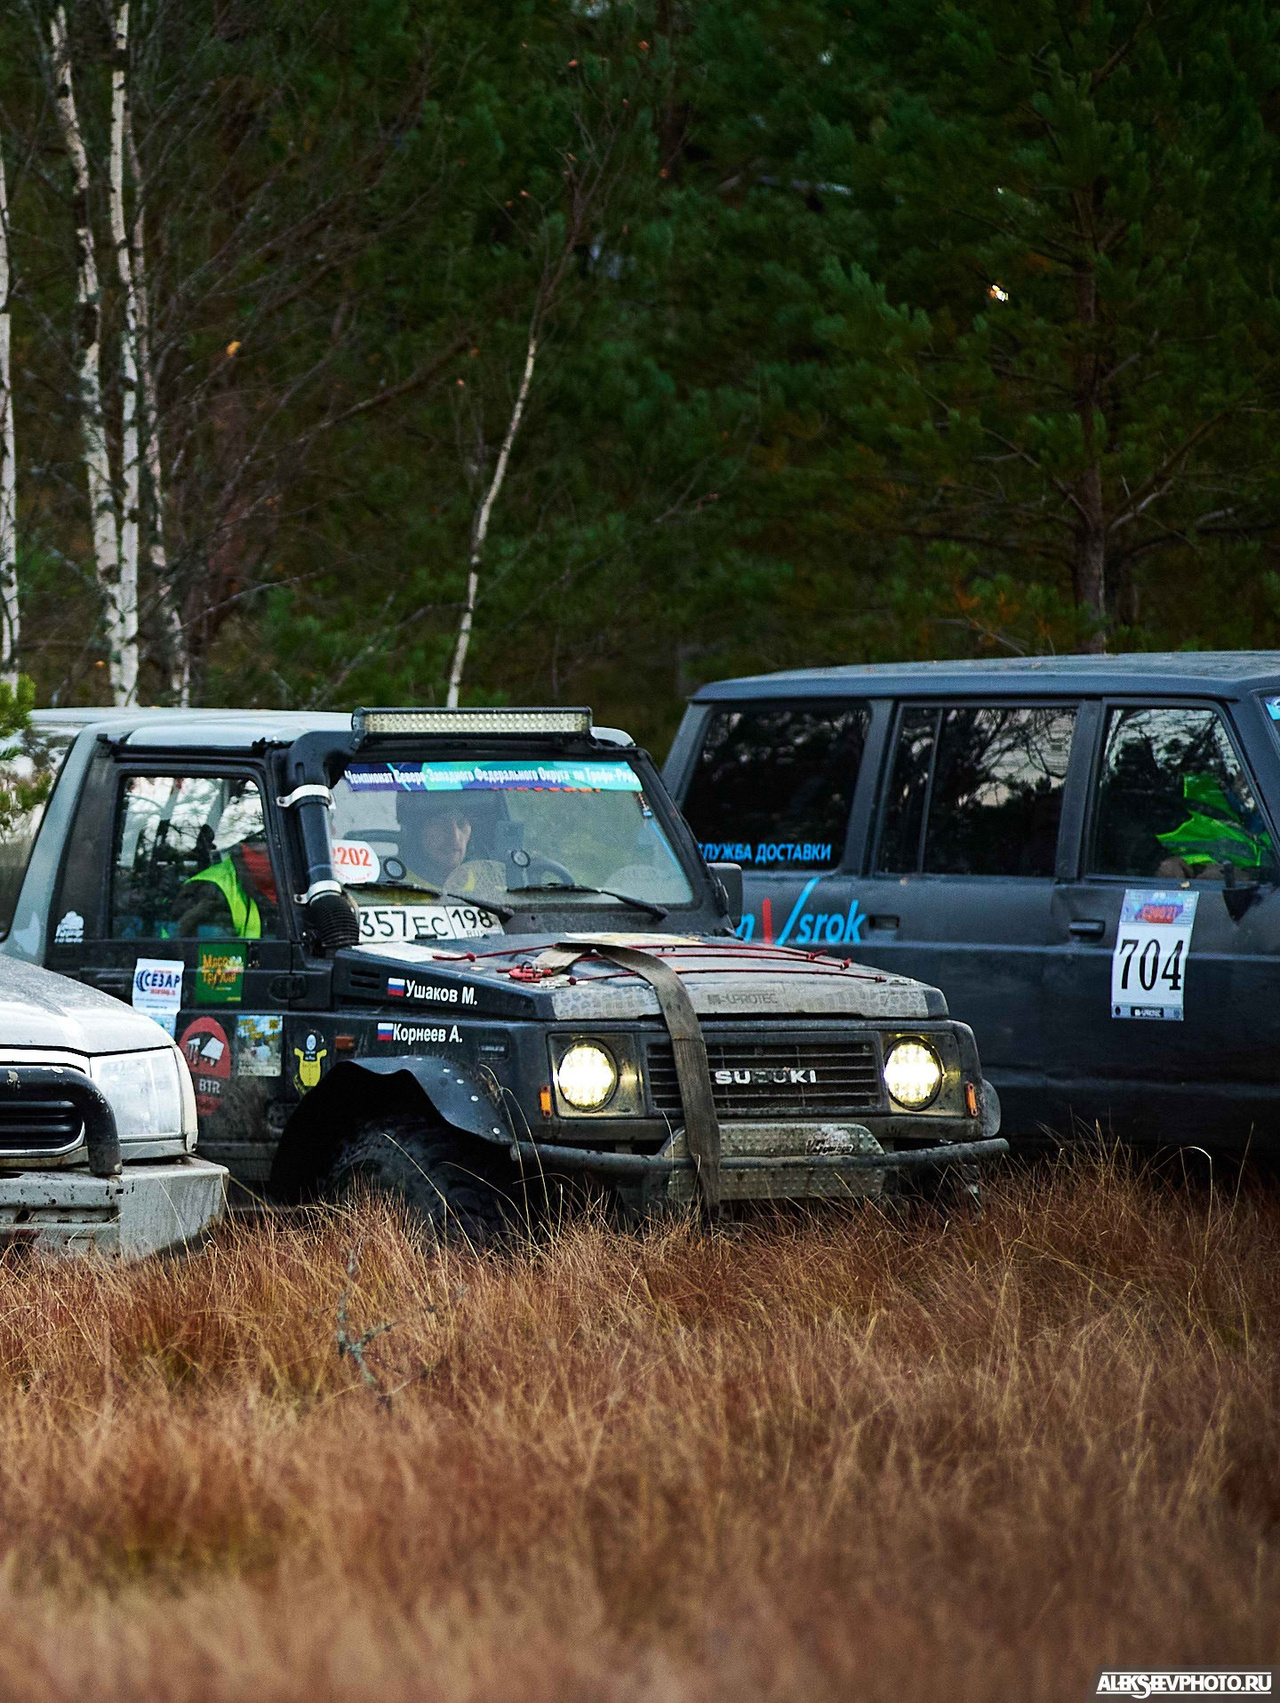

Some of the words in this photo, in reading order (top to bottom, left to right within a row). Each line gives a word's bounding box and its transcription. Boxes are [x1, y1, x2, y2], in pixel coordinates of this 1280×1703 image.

[344, 769, 394, 785] Чемпионат
[393, 768, 475, 786] Северо-Западного
[474, 766, 539, 784] Федерального
[538, 766, 570, 784] Округа
[755, 843, 832, 864] ДОСТАВКИ
[451, 908, 493, 928] 198
[1119, 939, 1184, 991] 704
[144, 971, 181, 988] СЕЗАР
[406, 979, 458, 1003] Ушаков
[461, 986, 478, 1005] М.
[393, 1023, 446, 1046] Корнеев
[448, 1024, 463, 1043] А.
